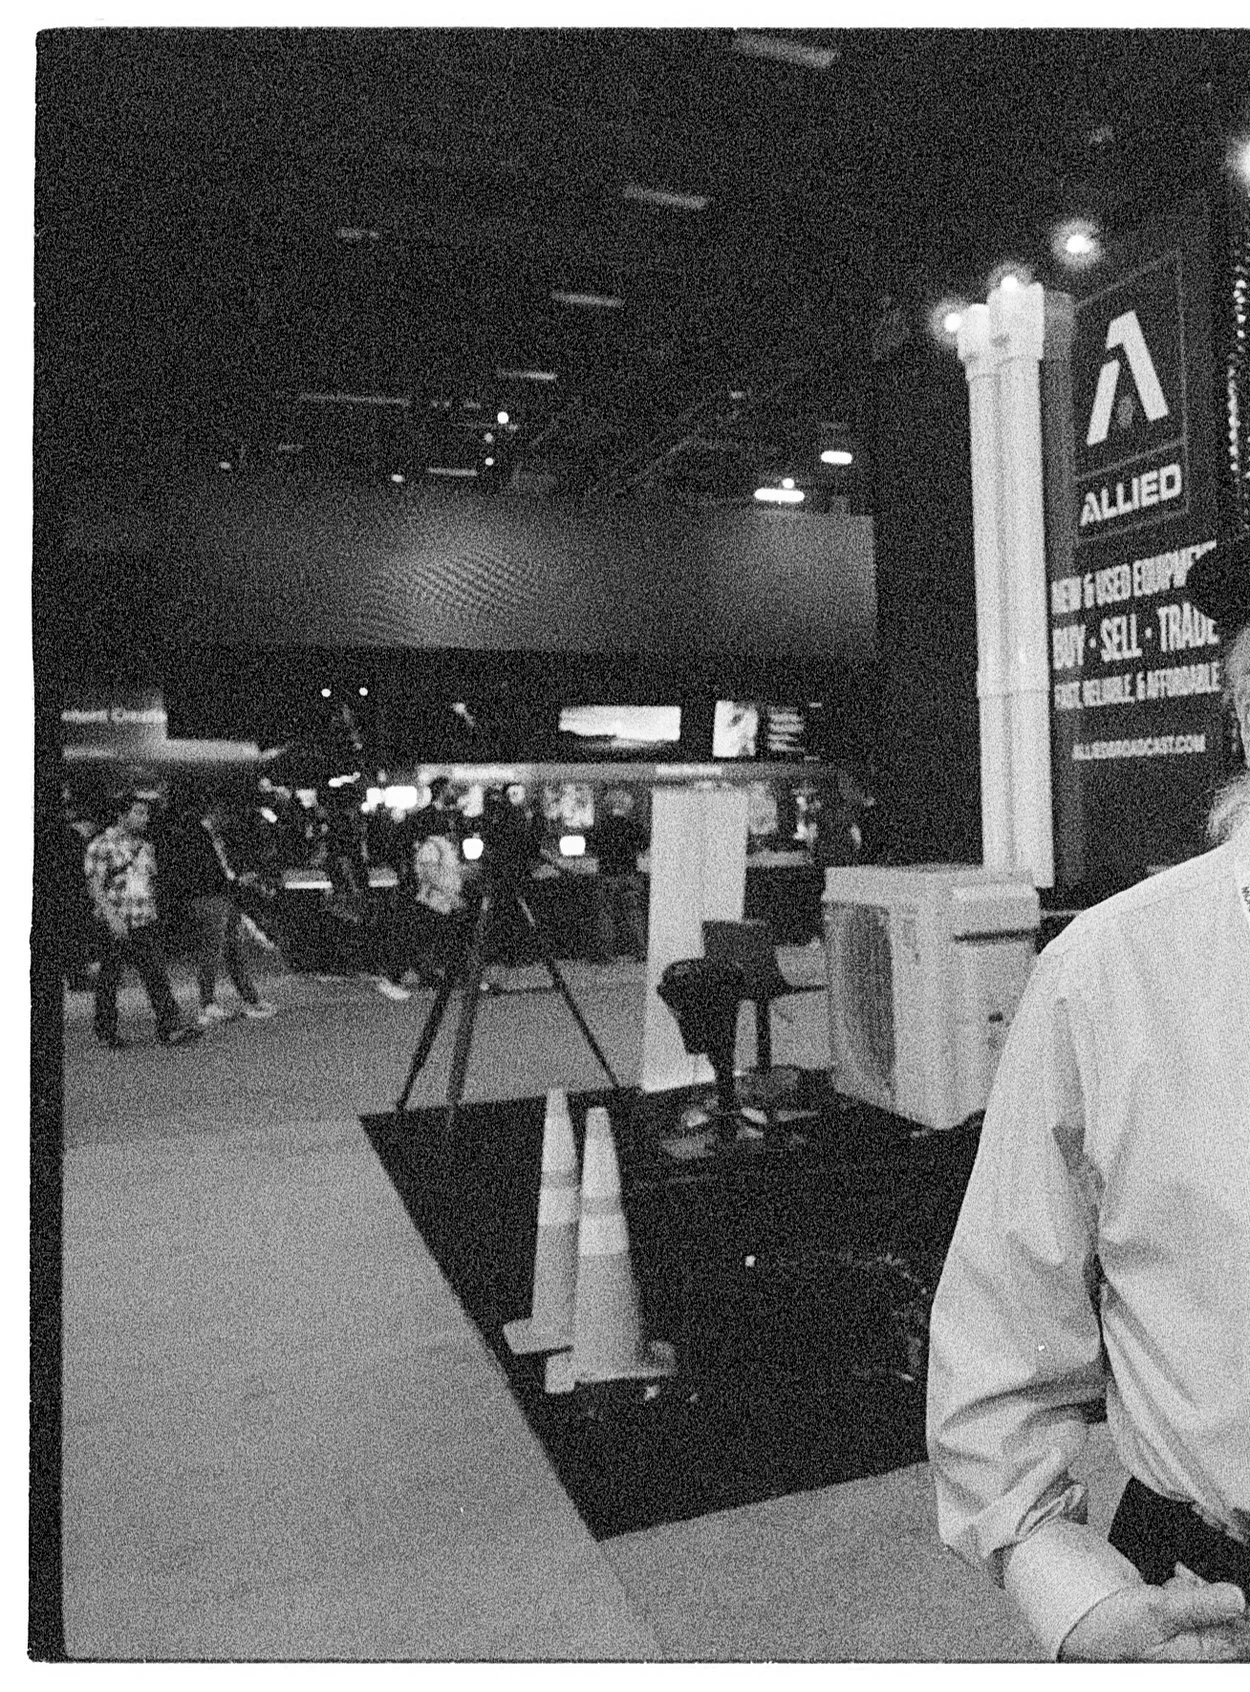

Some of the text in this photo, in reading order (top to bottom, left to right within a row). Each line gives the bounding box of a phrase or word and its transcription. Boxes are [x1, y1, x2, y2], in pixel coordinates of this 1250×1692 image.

[1079, 463, 1182, 527] ALLIED
[1096, 563, 1131, 606] USED
[1132, 540, 1217, 597] EQUIPM
[1052, 623, 1086, 670] BUY
[1099, 612, 1143, 663] SELL
